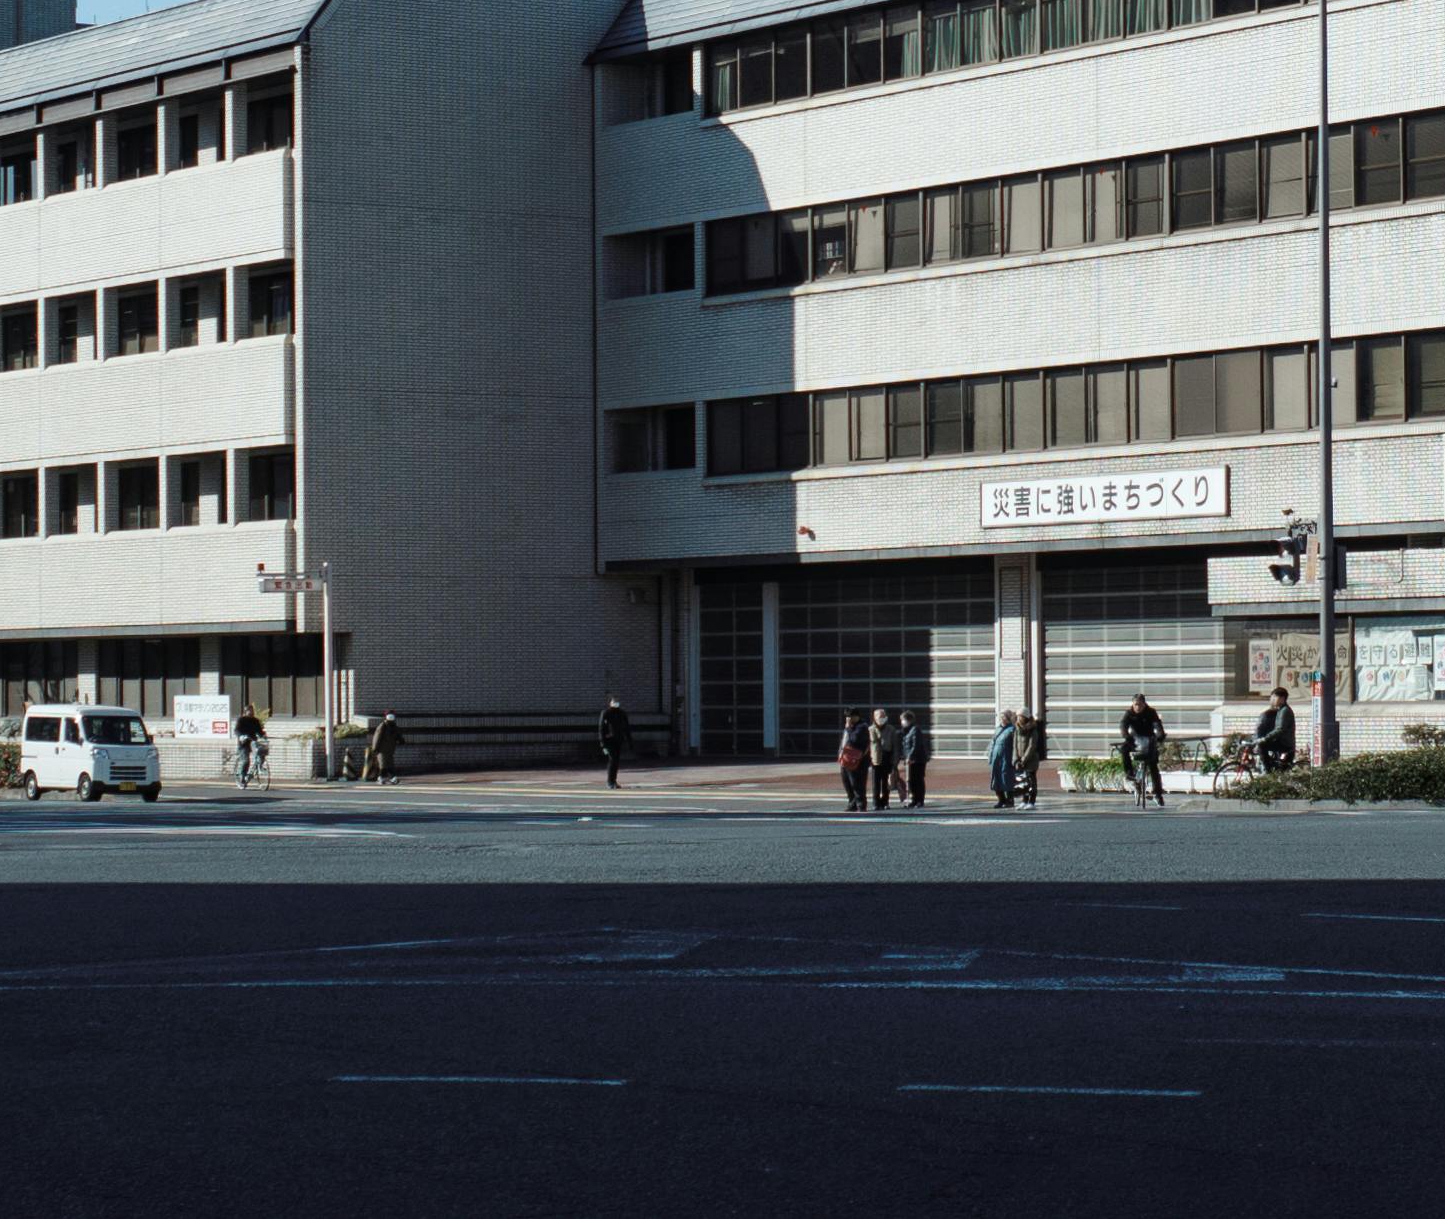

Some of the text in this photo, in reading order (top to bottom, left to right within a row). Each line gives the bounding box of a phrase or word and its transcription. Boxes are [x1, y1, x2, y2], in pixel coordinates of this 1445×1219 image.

[993, 476, 1209, 518] 災害に強いまちづくり
[1276, 641, 1432, 663] 火災か命を守る避難
